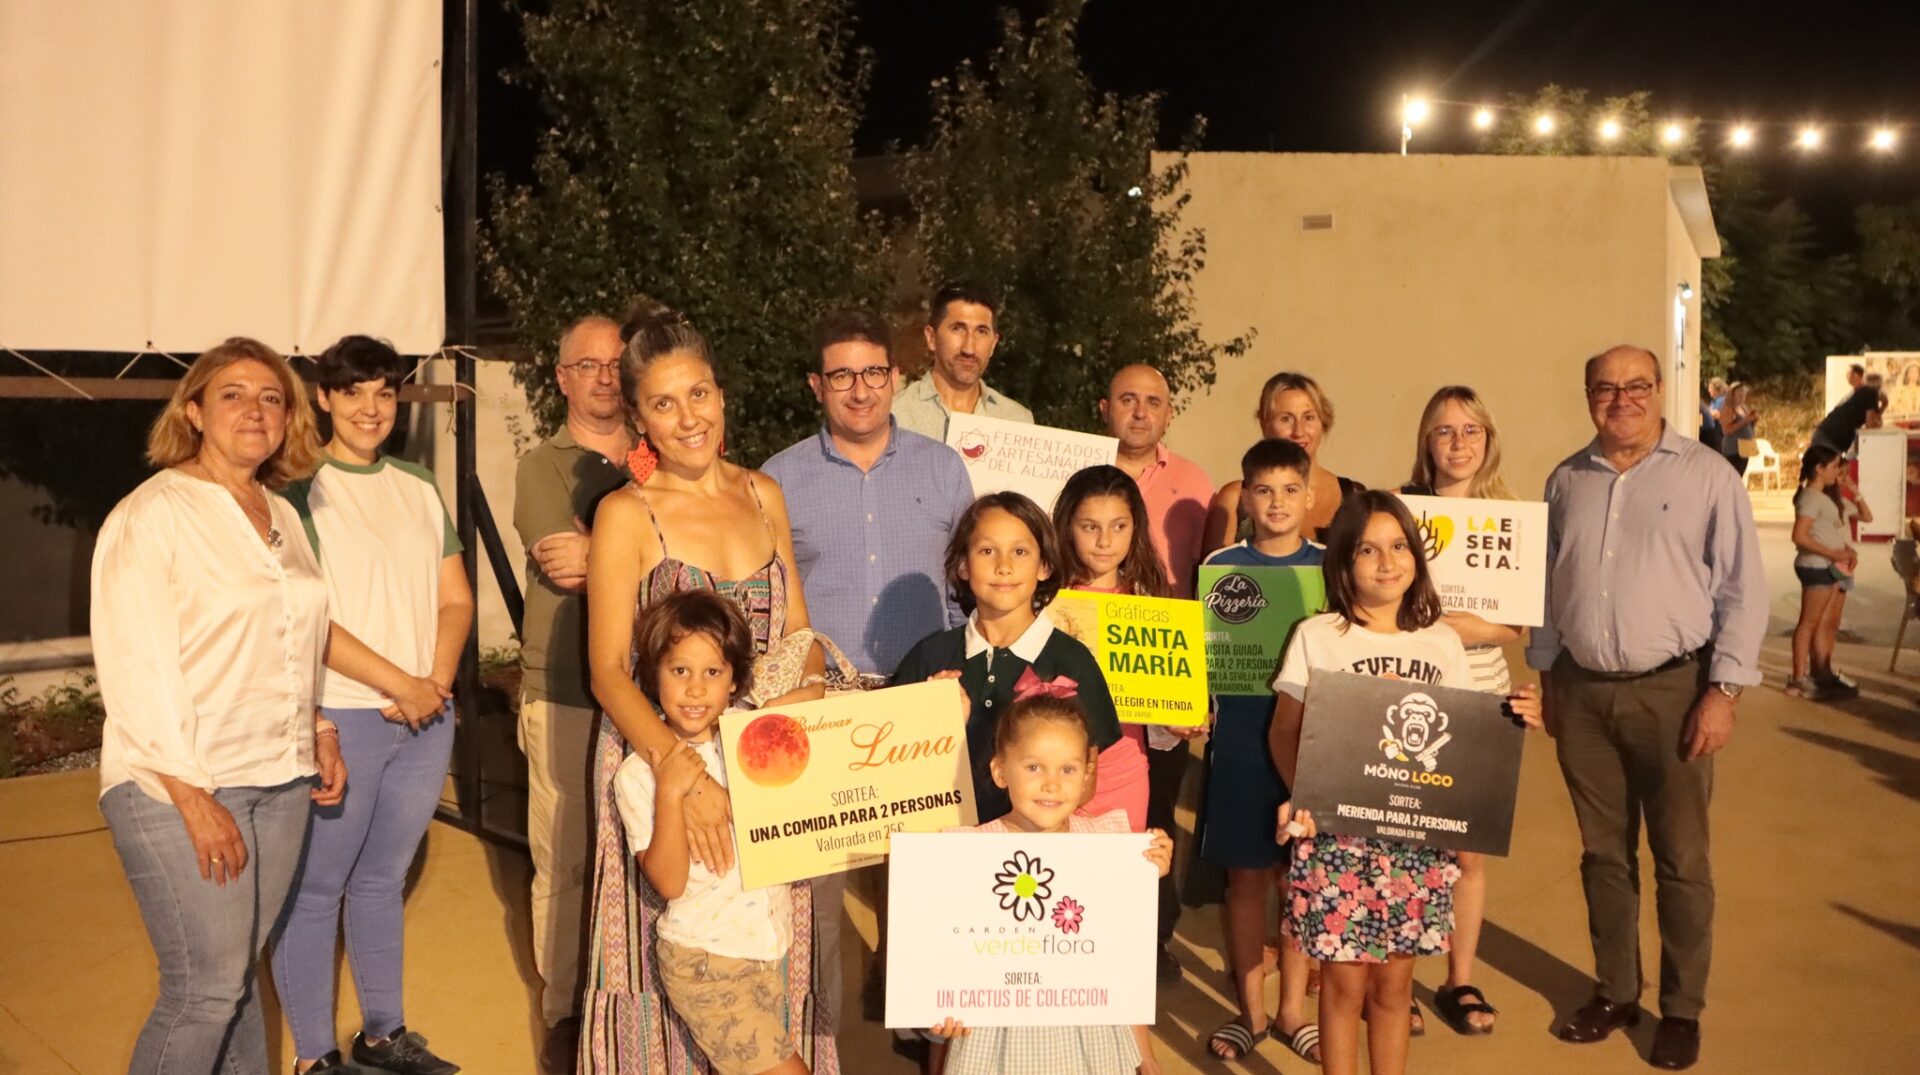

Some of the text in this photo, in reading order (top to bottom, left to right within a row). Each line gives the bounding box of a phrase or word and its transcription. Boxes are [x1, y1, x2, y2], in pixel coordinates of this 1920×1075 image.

[993, 431, 1102, 460] FERMENTADOS
[996, 447, 1101, 470] ARTESANALE
[989, 458, 1070, 481] DEL ALJAR
[1466, 534, 1512, 551] SEN
[1466, 552, 1520, 570] CIA.
[1224, 576, 1248, 592] La
[1106, 602, 1170, 623] Gráficas
[1438, 595, 1499, 610] GAZA DE PAN
[1107, 624, 1188, 650] SANTA
[1233, 645, 1264, 656] GUIADA
[1110, 651, 1192, 678] MARÍA
[1228, 658, 1234, 670] 2
[1114, 696, 1193, 711] ELEGIR EN TIENDA
[786, 714, 852, 736] Bulevar
[848, 721, 956, 772] Luna
[1412, 770, 1454, 788] LOCO
[831, 785, 880, 807] SORTEA:
[1389, 794, 1422, 810] SORTEA:
[750, 790, 962, 844] UNA COMIDA PARA 2 PERSONAS
[1337, 804, 1468, 834] MERIENDA PARA 2 PERSONAS
[816, 831, 866, 852] Valorada
[868, 830, 882, 842] en
[1376, 825, 1406, 838] VALORADA
[953, 926, 1036, 934] GARDEN
[974, 934, 1095, 955] verdeflora
[1004, 972, 1043, 986] SORTEA:
[936, 987, 1108, 1008] UN CACTUS DE COLECCIÓN
